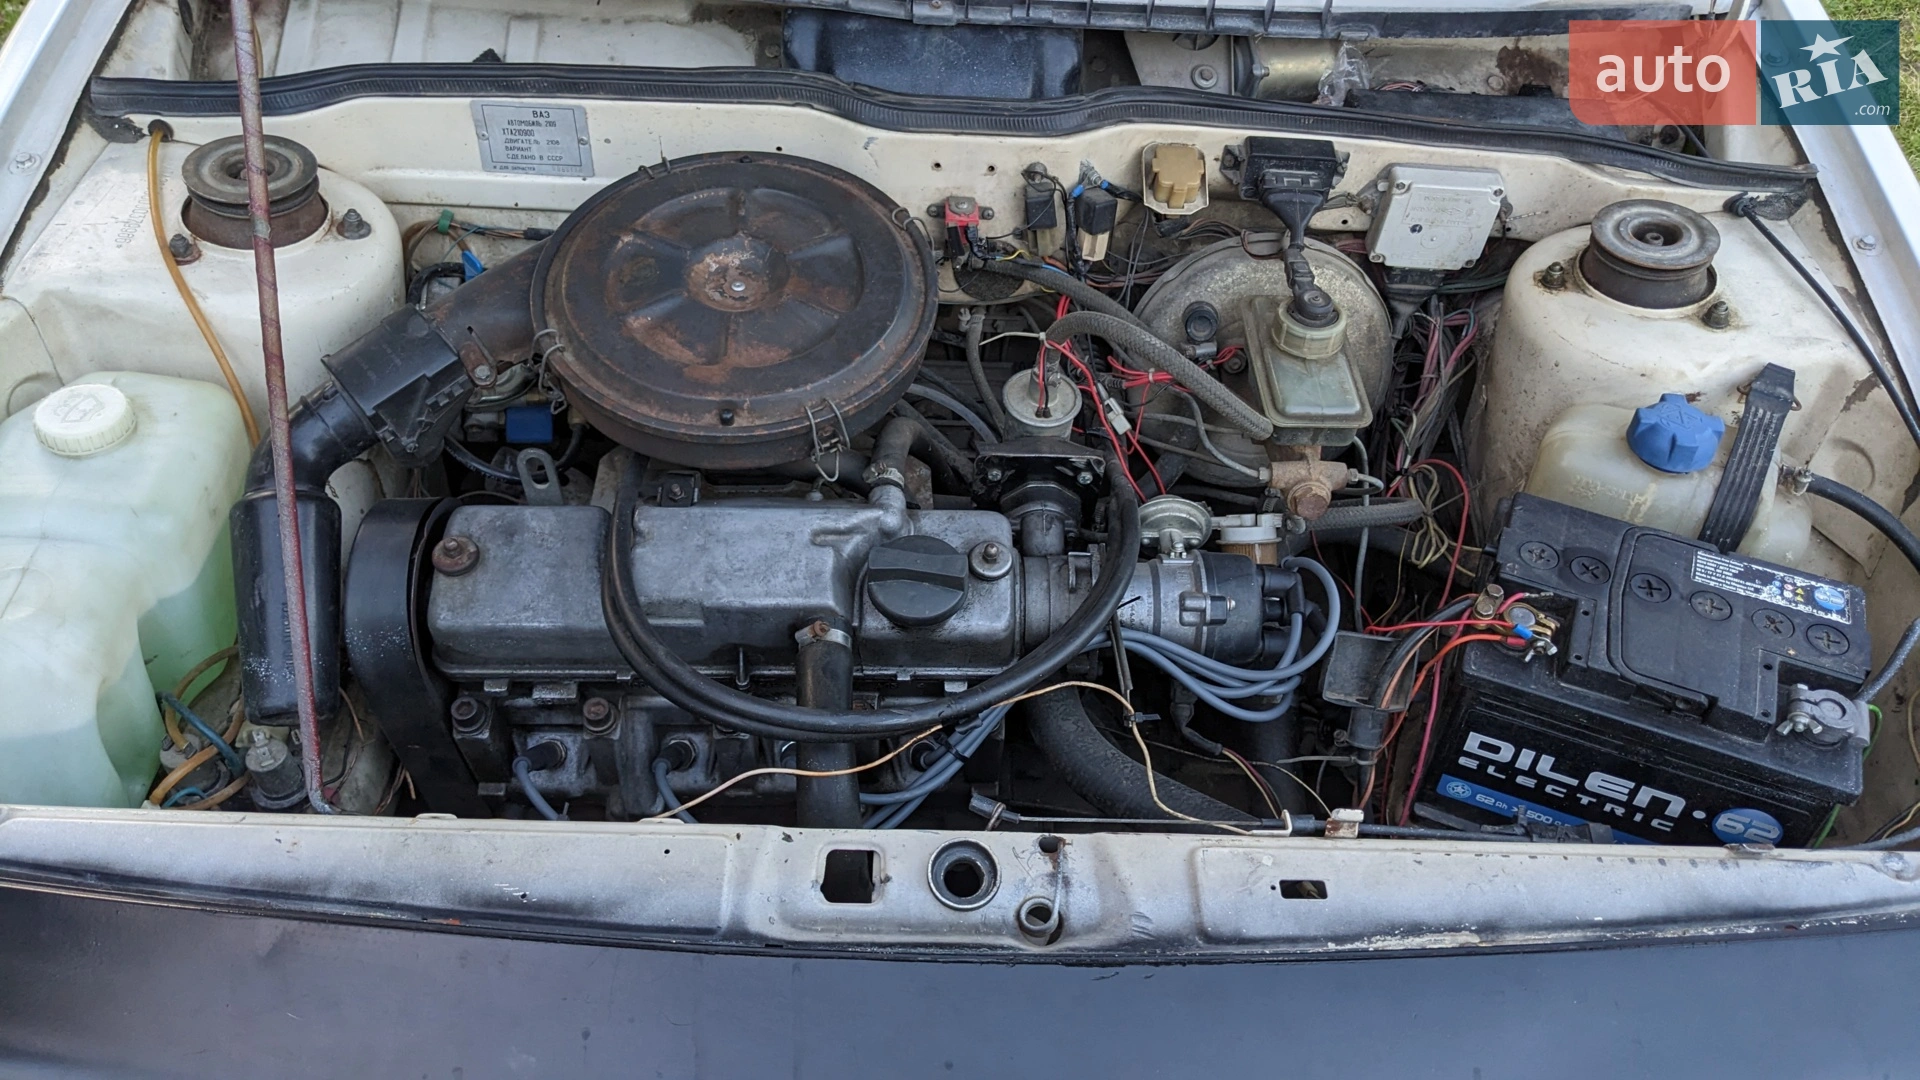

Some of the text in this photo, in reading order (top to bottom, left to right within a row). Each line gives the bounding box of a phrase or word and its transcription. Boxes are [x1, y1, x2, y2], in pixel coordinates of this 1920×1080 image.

[507, 119, 542, 128] АВТОМОБИЛЬ
[532, 110, 550, 119] ВАЗ
[1463, 731, 1686, 819] DILEN
[1458, 756, 1675, 832] ELECTRIC
[1475, 793, 1496, 806] 62
[1496, 800, 1508, 810] Ah
[1525, 810, 1553, 824] 500
[1715, 812, 1780, 845] 62
